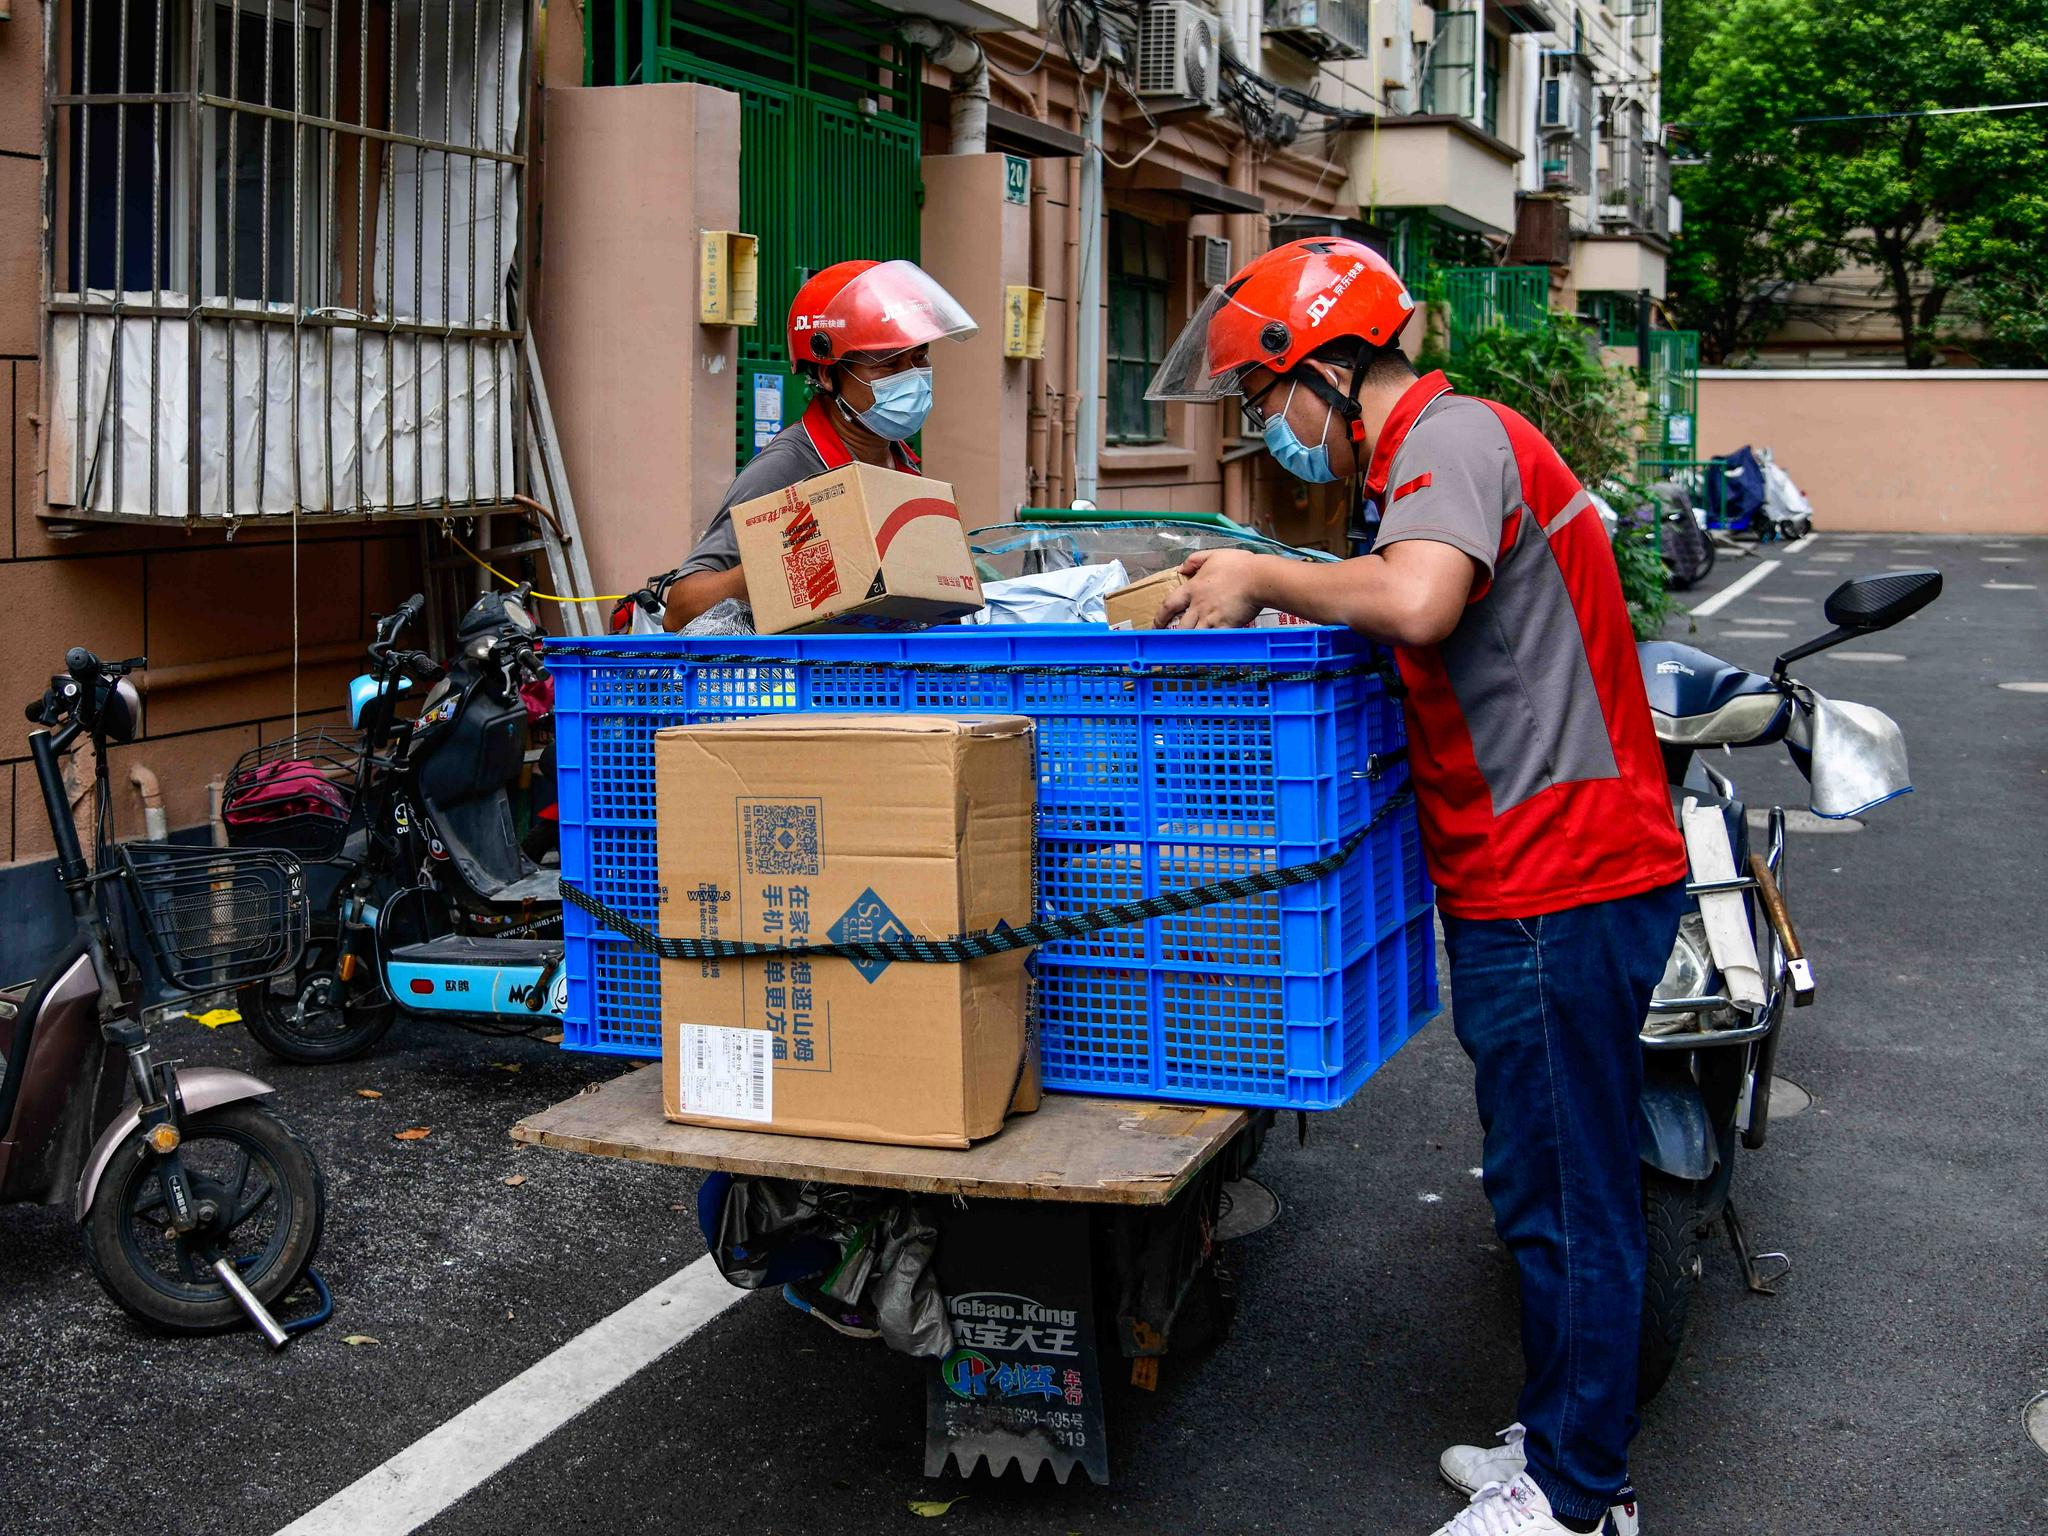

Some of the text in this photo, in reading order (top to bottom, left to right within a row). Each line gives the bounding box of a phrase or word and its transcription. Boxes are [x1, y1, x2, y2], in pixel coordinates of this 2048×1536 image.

[1009, 163, 1024, 188] 20
[794, 315, 811, 331] JDL
[1306, 262, 1366, 328] JDL 京东快递
[872, 582, 884, 594] 12
[707, 883, 720, 978] 更的生活山姆
[857, 902, 881, 968] Sas
[762, 884, 788, 1061] 手机单更方便
